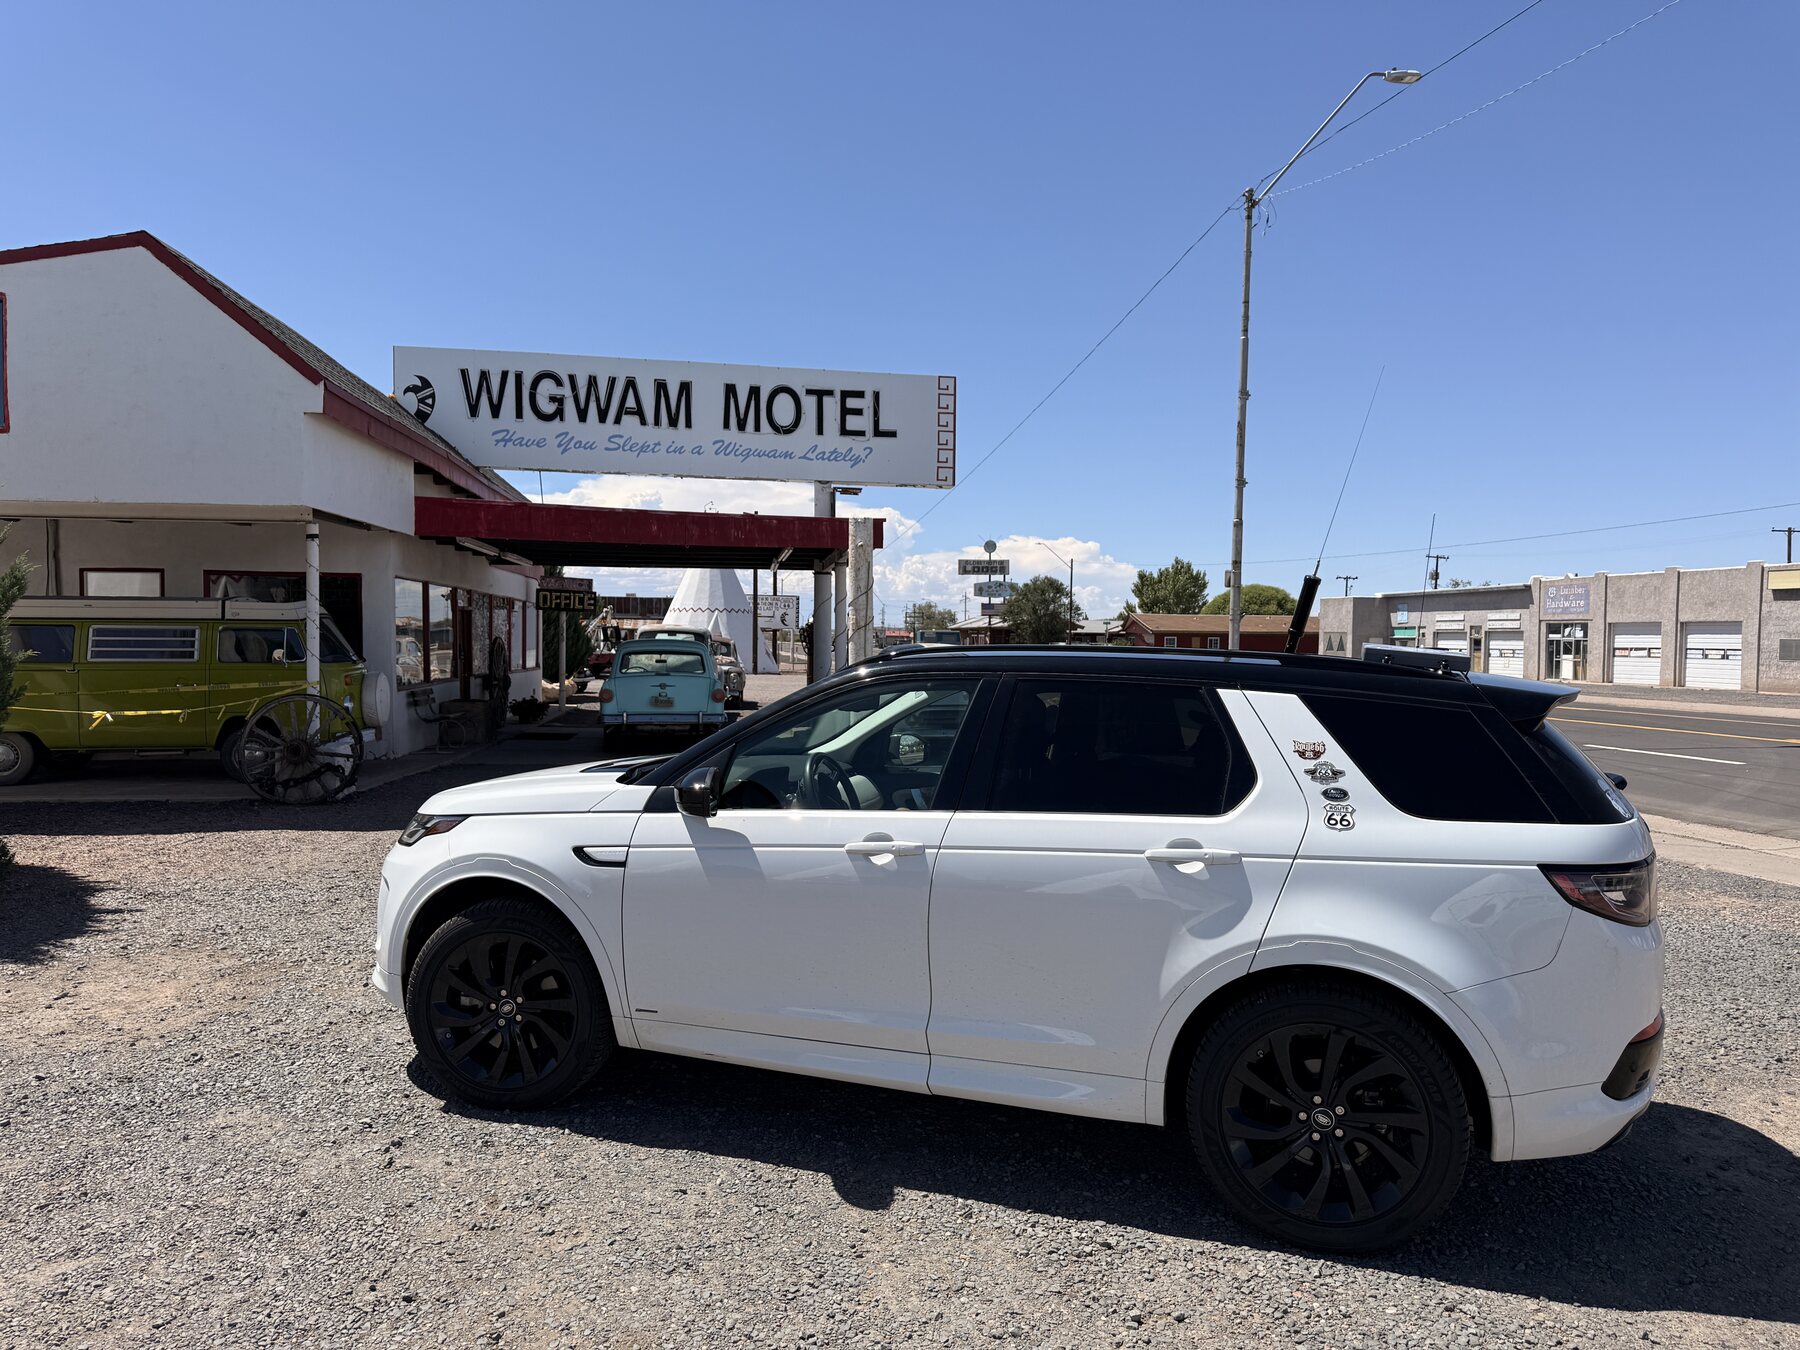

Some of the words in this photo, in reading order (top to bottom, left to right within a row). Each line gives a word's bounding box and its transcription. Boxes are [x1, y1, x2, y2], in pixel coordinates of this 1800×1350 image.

[458, 368, 692, 429] WIGWAM
[723, 383, 897, 438] MOTEL
[491, 428, 547, 448] Have
[555, 431, 597, 455] You
[604, 433, 661, 457] Slept
[666, 439, 686, 456] in
[690, 445, 704, 456] a
[712, 439, 796, 463] Wigwam
[798, 443, 873, 468] Lately?
[963, 565, 1006, 573] LODGE
[1561, 585, 1585, 594] Lumber
[539, 592, 595, 609] OFFICE
[1547, 598, 1585, 608] Hardware
[1293, 740, 1315, 752] Route
[1315, 741, 1326, 753] 66
[1327, 813, 1351, 827] 66
